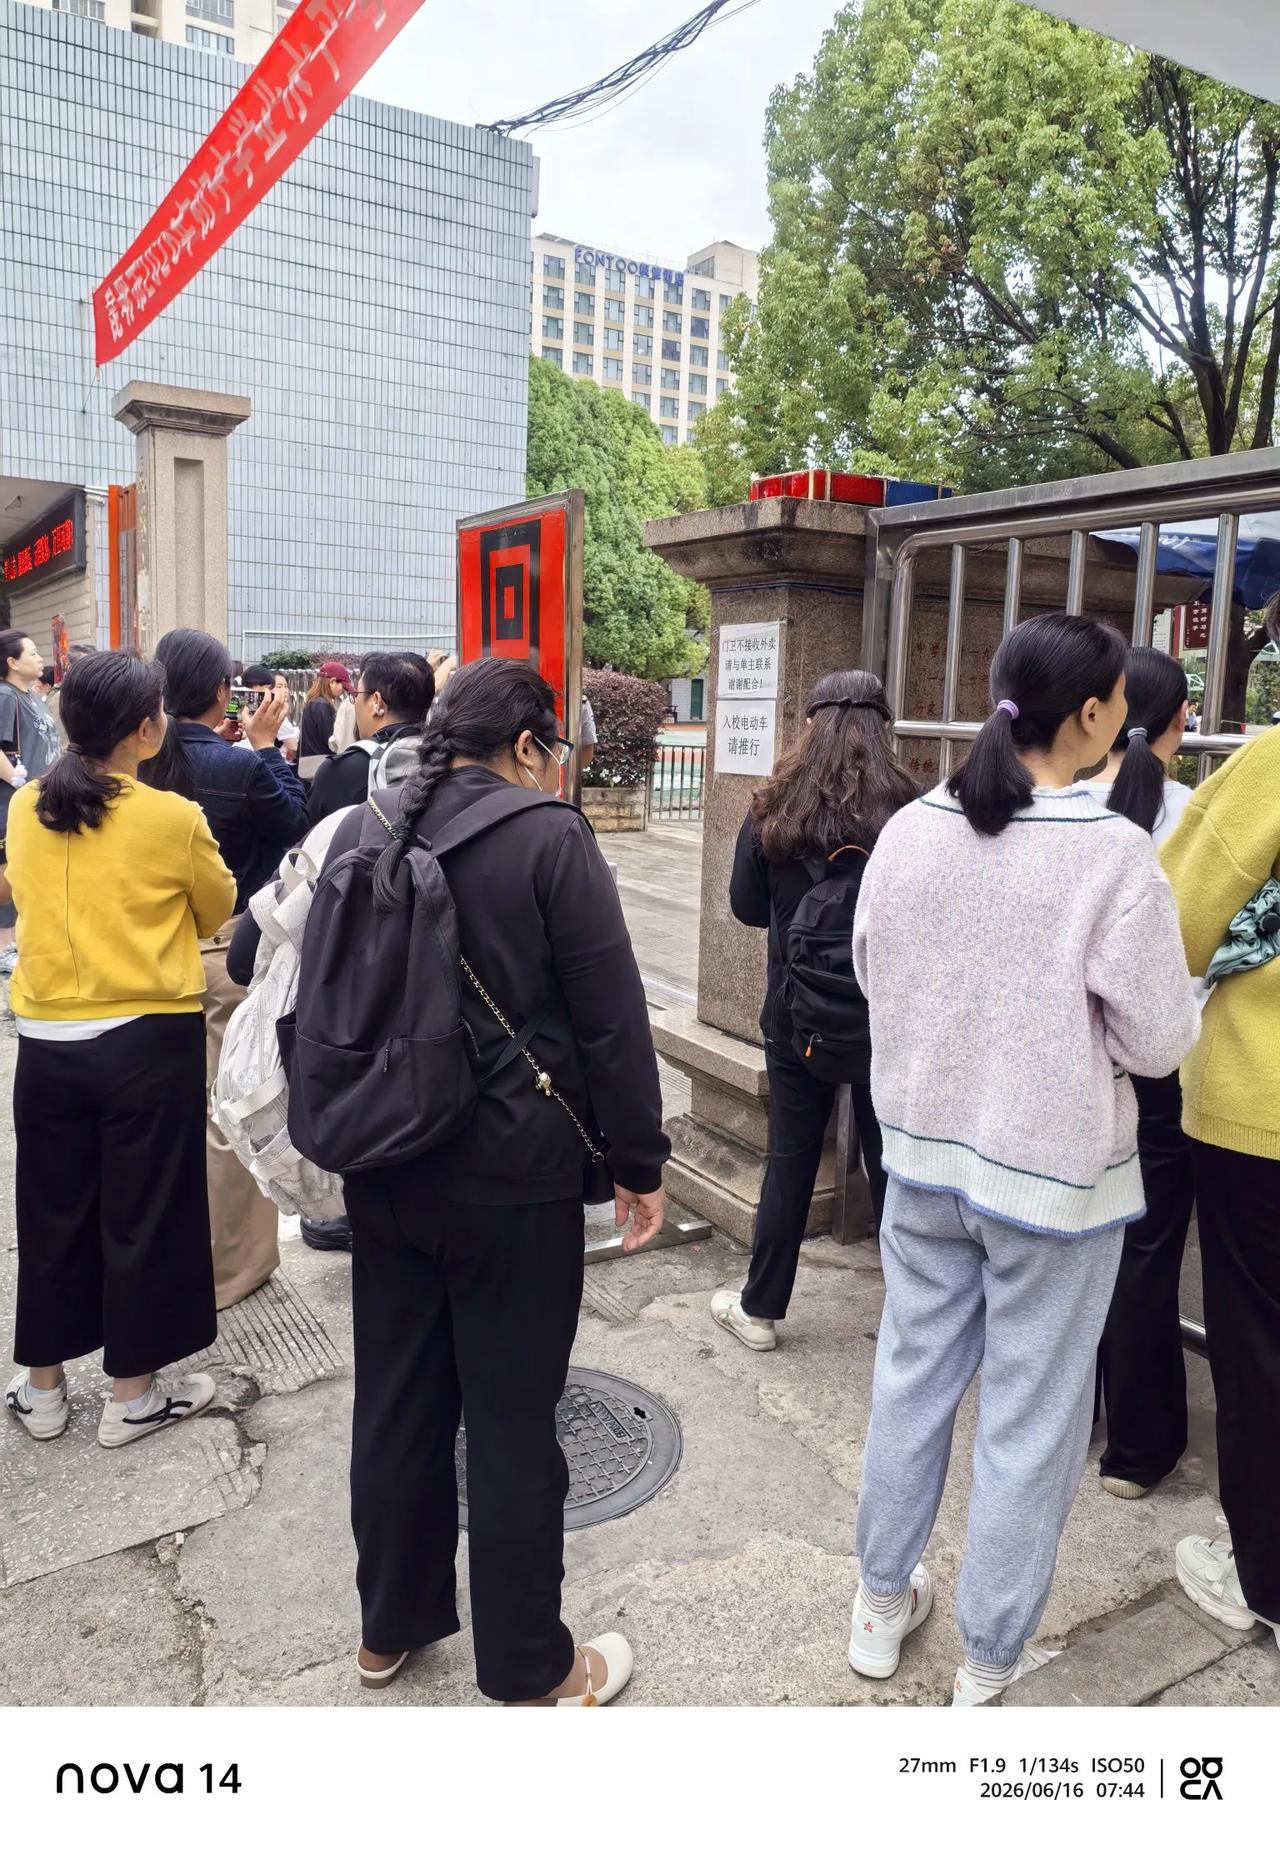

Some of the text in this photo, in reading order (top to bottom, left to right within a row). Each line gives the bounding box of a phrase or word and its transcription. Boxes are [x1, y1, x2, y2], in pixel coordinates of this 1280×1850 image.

[722, 638, 776, 652] 门卫不接收外卖
[725, 657, 771, 671] 请与单主联系
[723, 715, 768, 731] 入校电动车
[728, 737, 760, 756] 请推行
